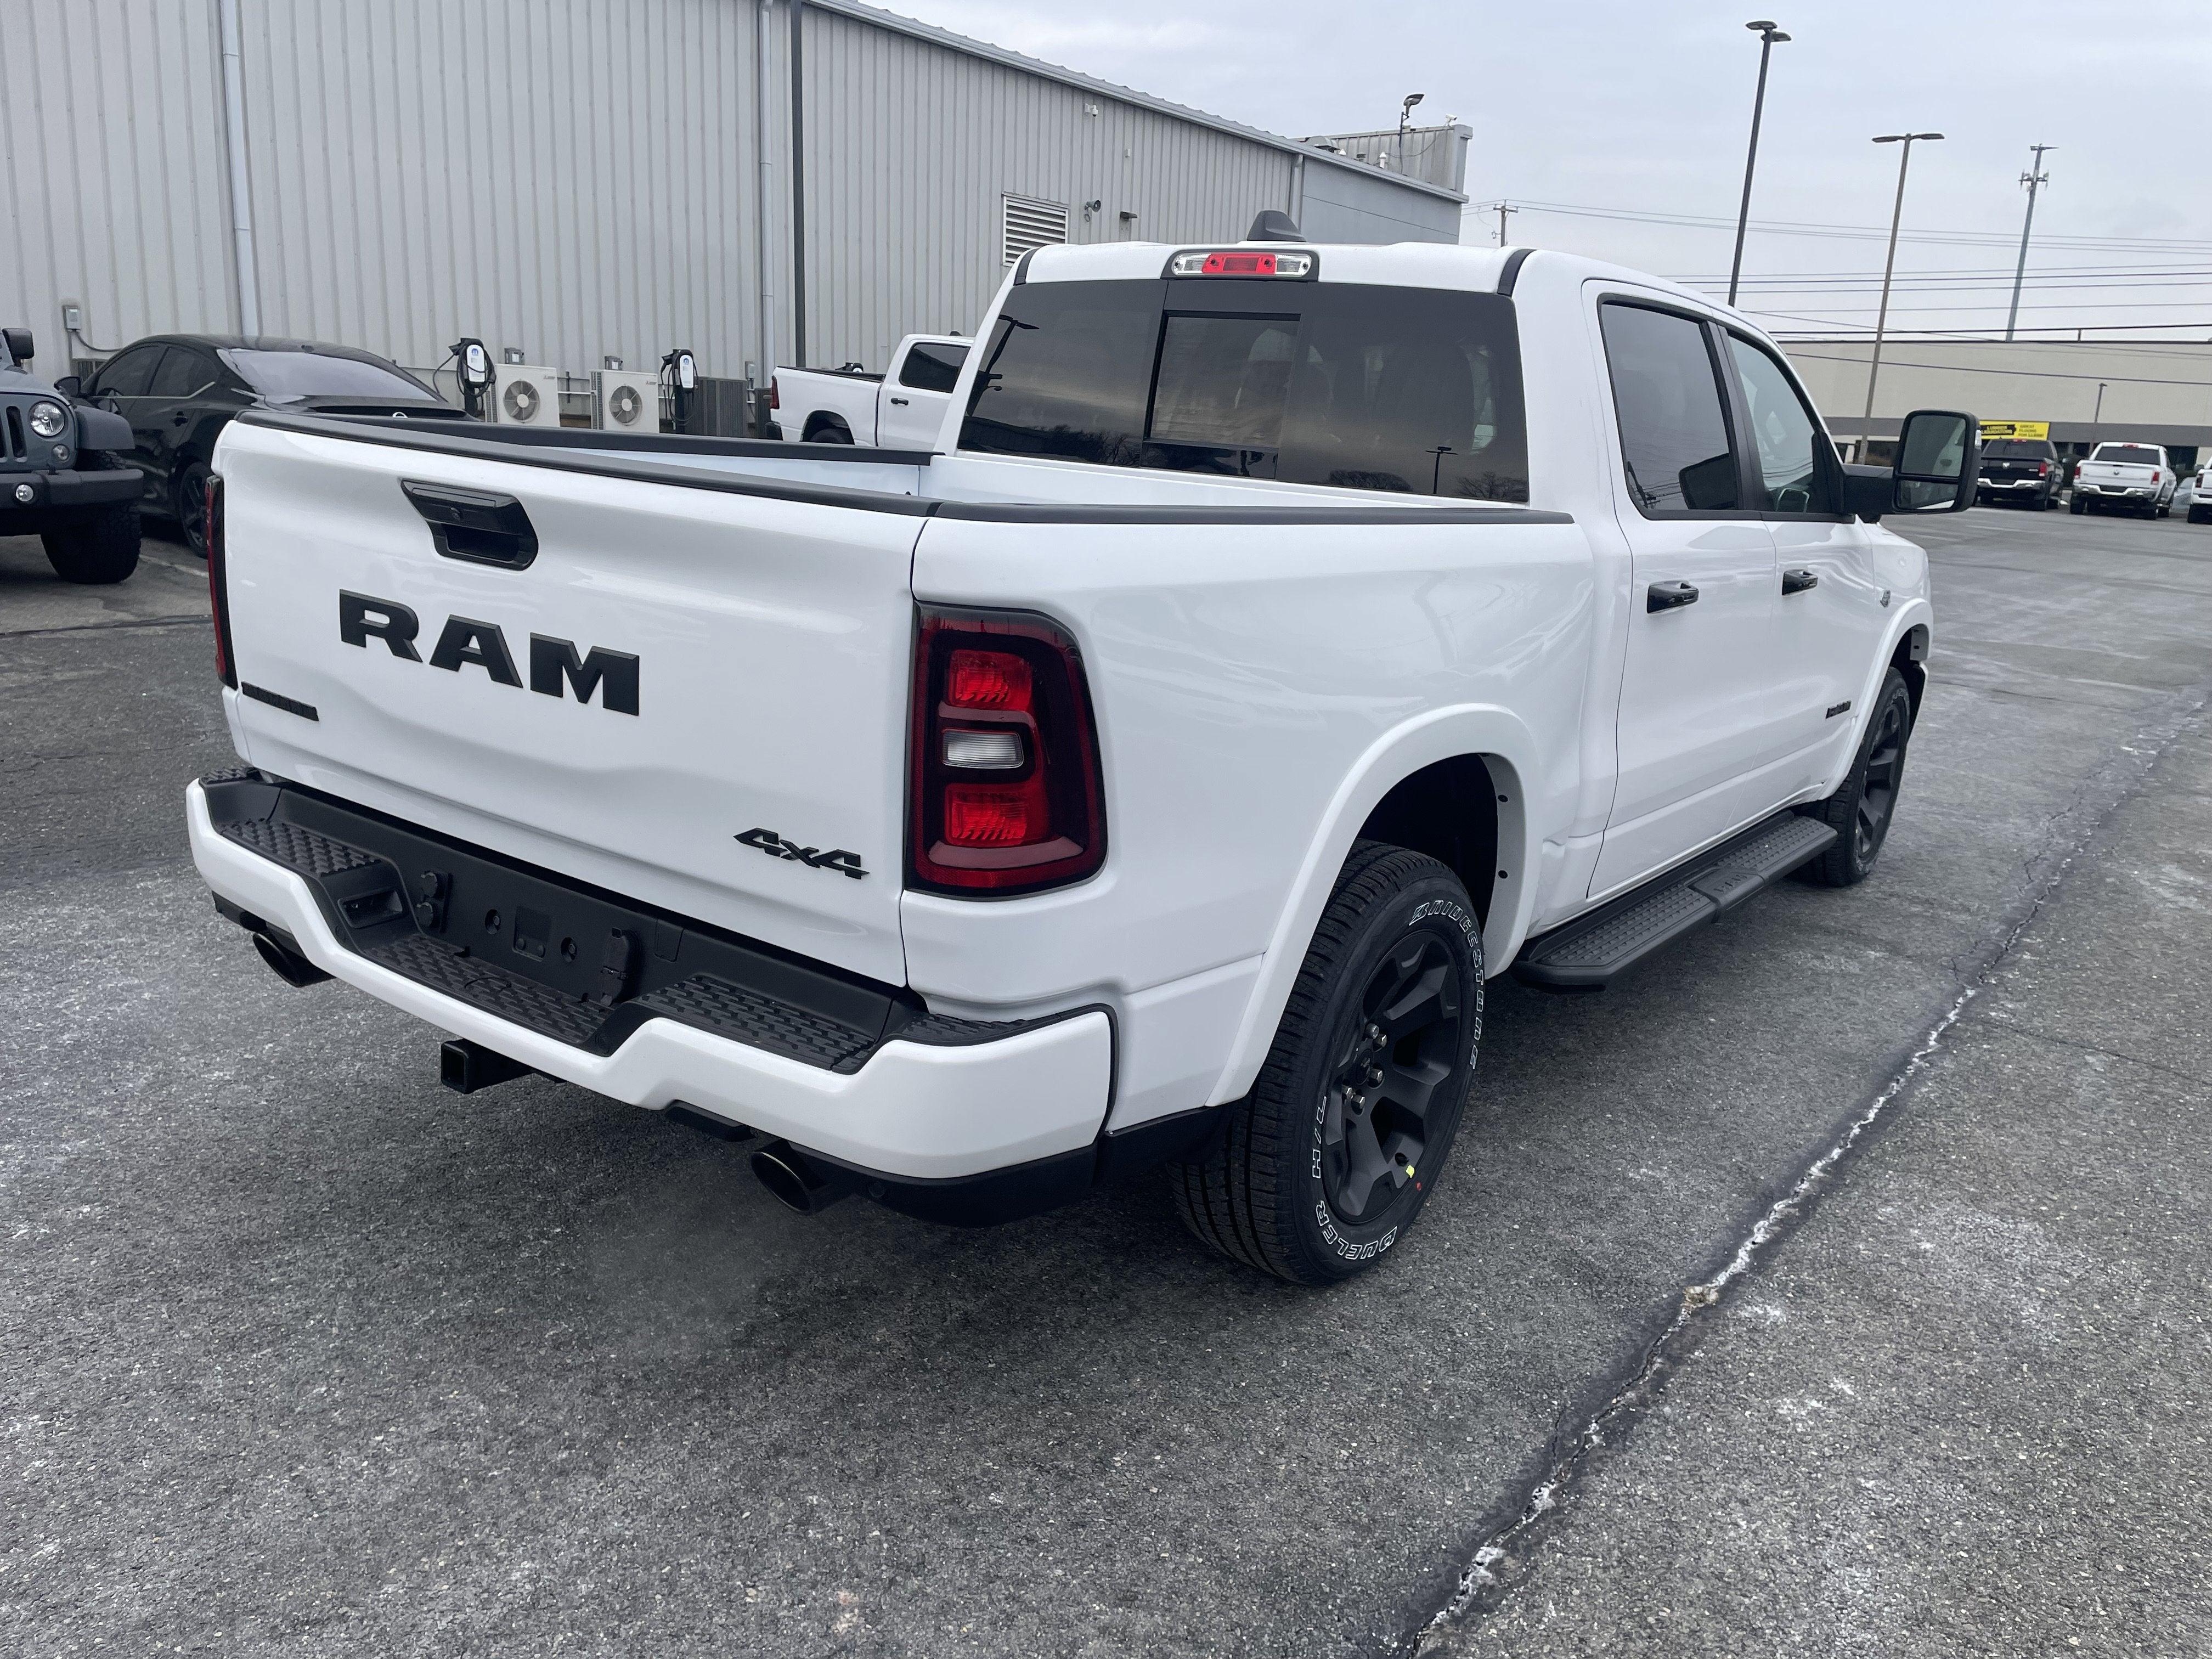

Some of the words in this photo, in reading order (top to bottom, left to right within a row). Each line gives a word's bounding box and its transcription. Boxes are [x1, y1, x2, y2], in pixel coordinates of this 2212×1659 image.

[340, 589, 640, 716] RAM
[1408, 900, 1484, 1070] BRIDGESTONE
[1316, 1200, 1398, 1261] DUELER
